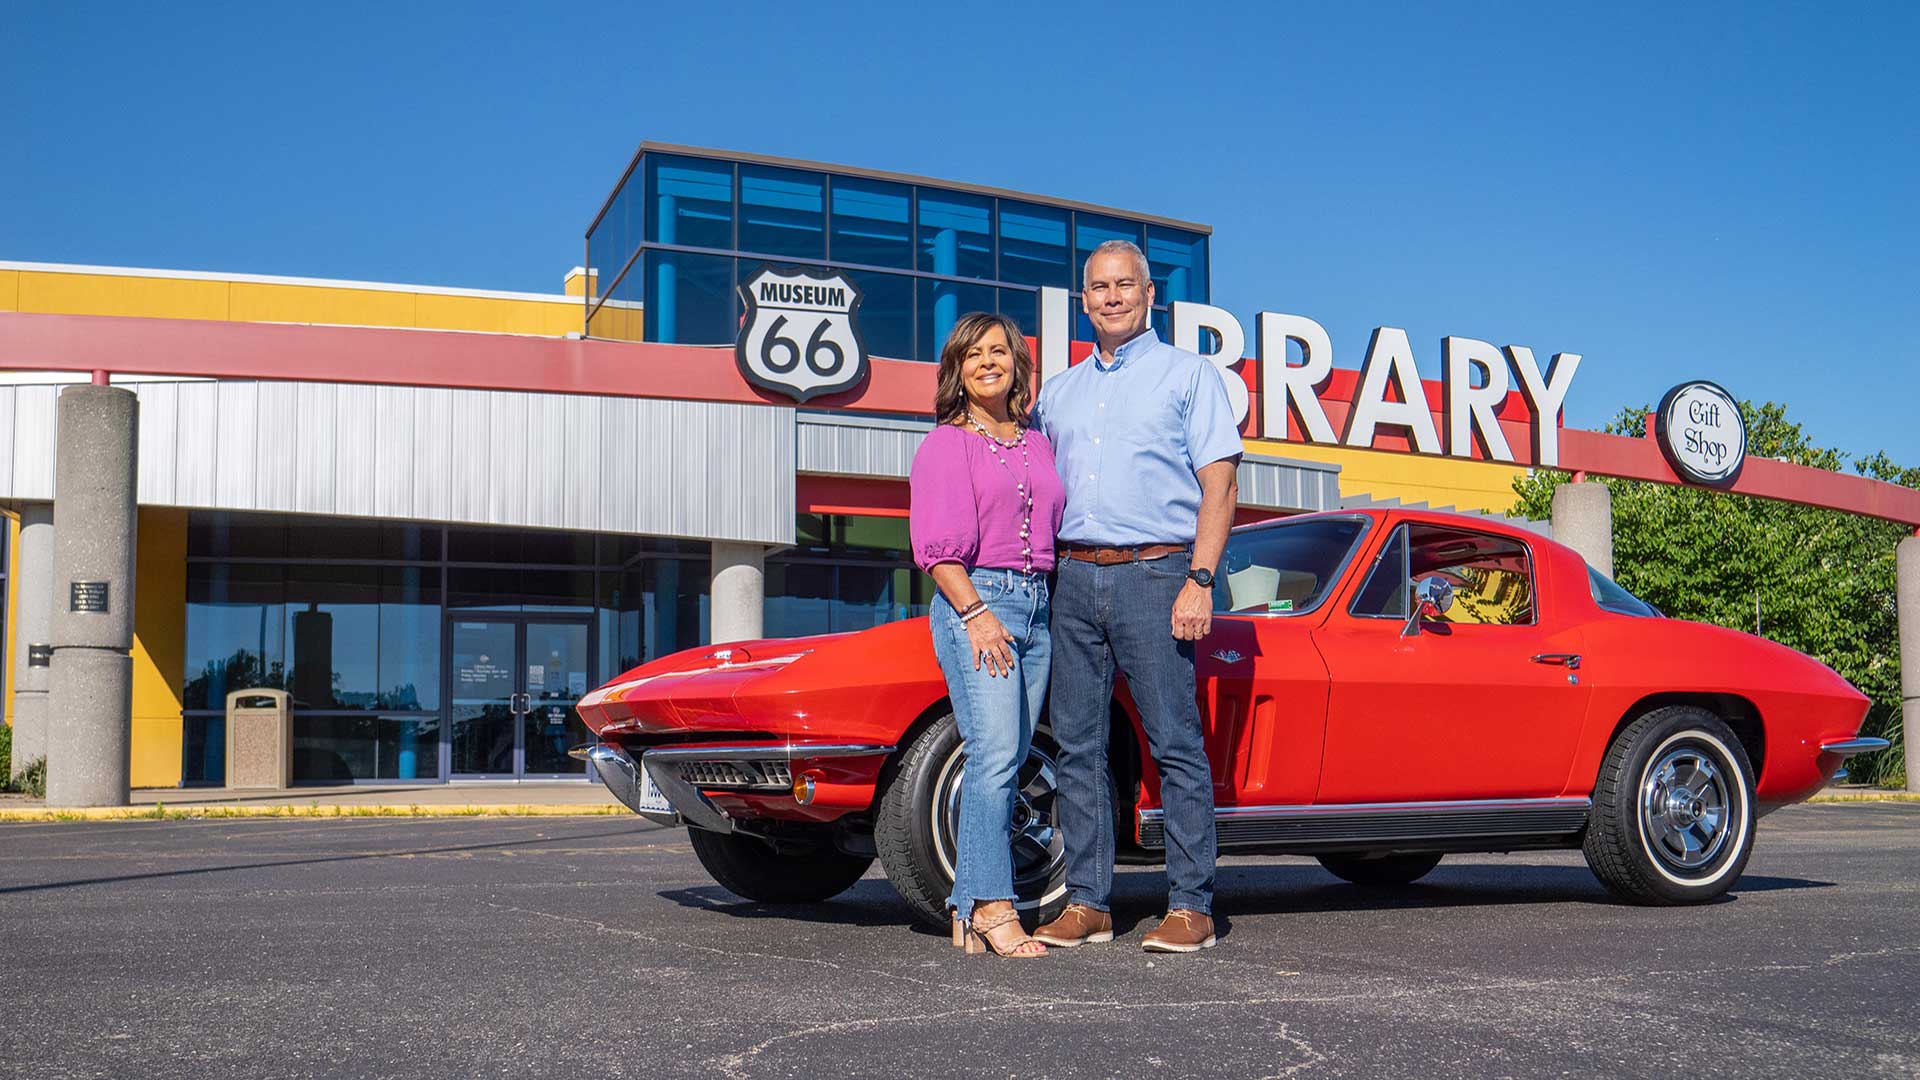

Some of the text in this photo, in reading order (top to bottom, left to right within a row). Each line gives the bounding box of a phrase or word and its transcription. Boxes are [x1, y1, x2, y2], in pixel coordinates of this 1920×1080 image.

[760, 282, 846, 307] MUSEUM
[760, 315, 845, 377] 66
[1040, 286, 1583, 467] LBRARY
[1689, 400, 1721, 428] Gift
[1684, 427, 1727, 465] Shop
